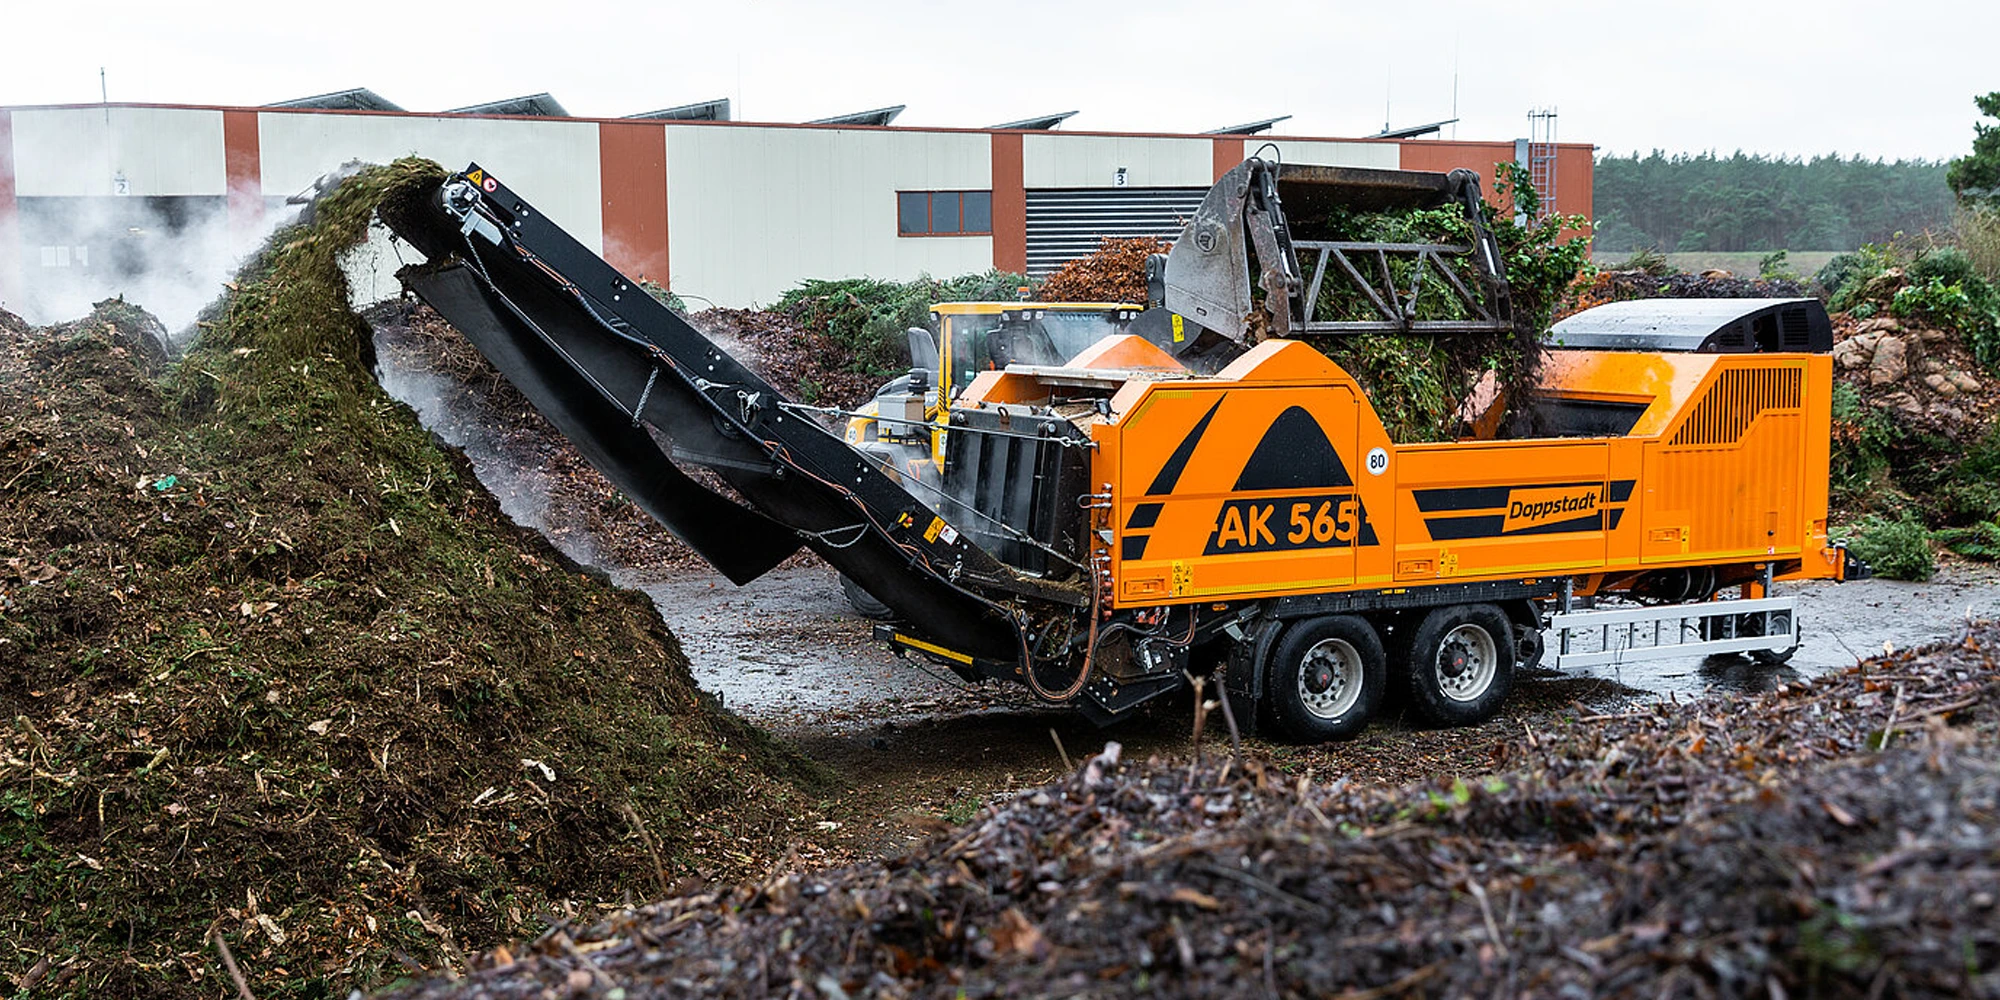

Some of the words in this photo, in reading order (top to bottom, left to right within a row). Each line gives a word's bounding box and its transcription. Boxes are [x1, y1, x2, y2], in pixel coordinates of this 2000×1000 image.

[1117, 174, 1125, 186] 3
[118, 183, 127, 194] 2
[1370, 454, 1385, 469] 80
[1509, 492, 1596, 521] Doppstadt
[1217, 504, 1276, 548] AK
[1287, 501, 1360, 544] 565
